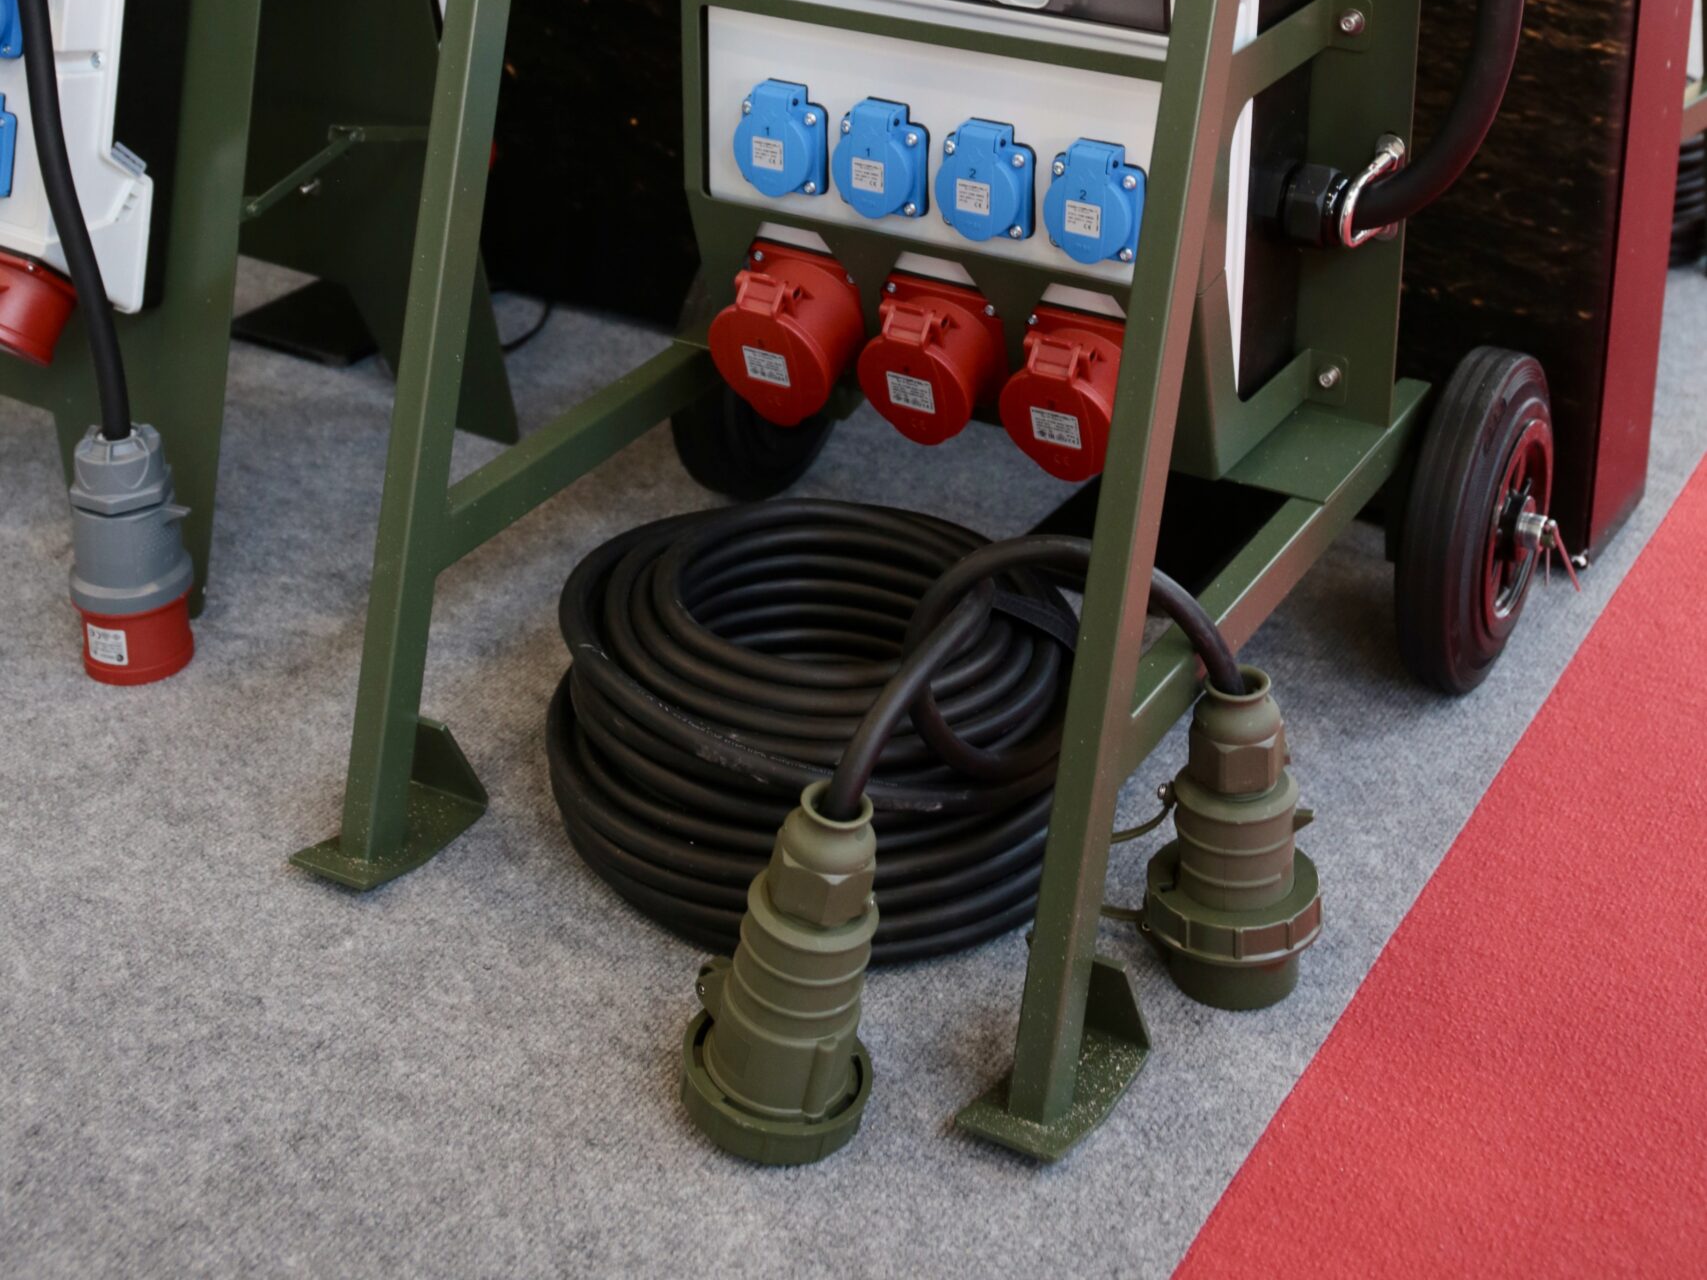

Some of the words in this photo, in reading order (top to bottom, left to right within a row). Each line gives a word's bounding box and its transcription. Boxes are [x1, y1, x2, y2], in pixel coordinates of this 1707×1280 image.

[764, 126, 771, 137] 1
[865, 147, 871, 158] 1
[968, 167, 977, 179] 2
[1079, 189, 1088, 201] 2
